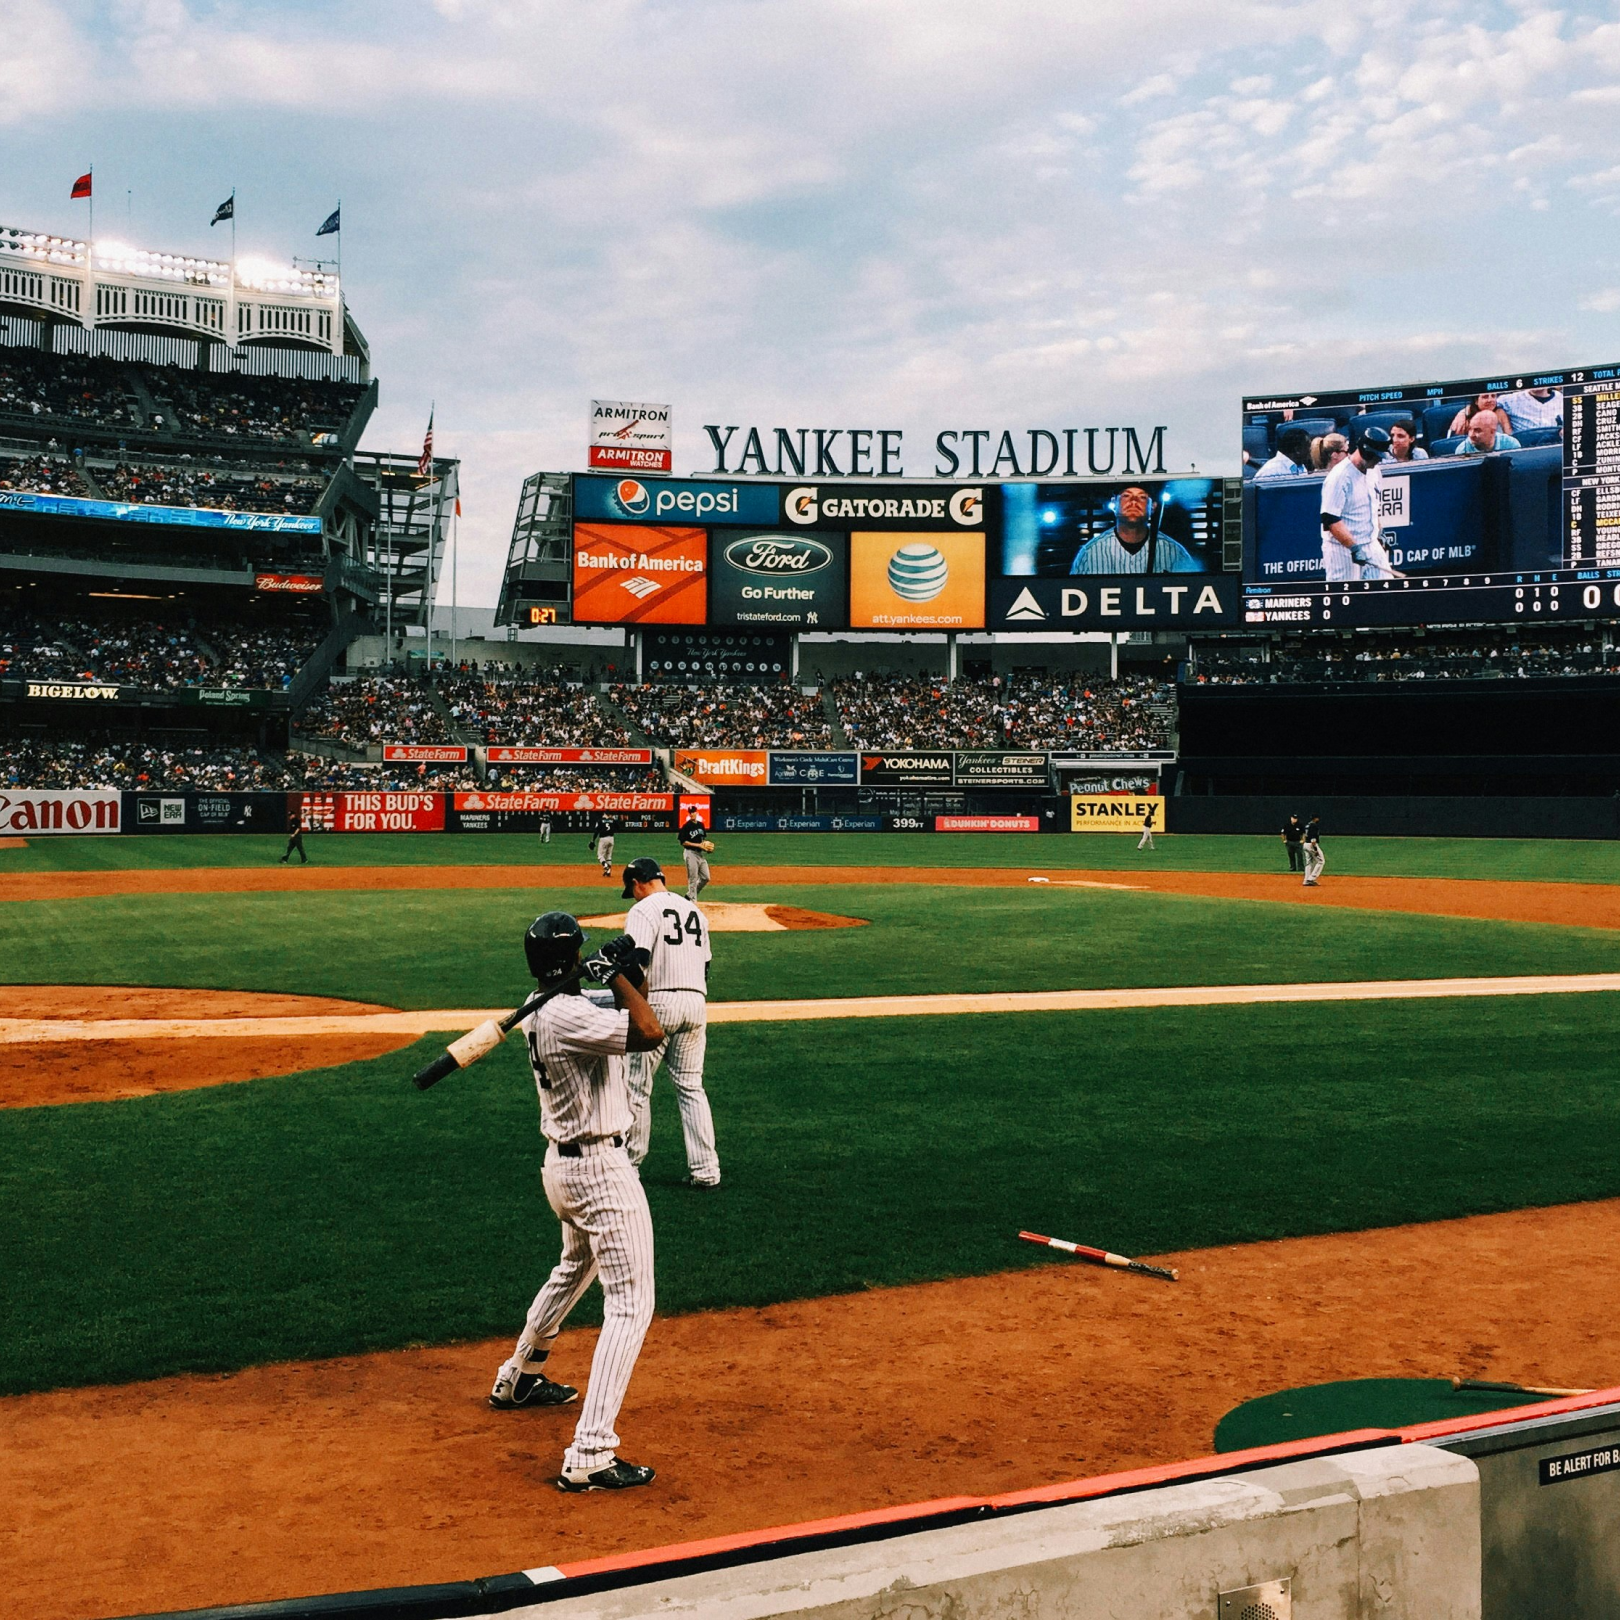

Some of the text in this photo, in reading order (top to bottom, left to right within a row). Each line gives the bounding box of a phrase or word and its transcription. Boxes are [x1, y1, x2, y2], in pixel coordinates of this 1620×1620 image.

[1487, 381, 1508, 390] BALLS
[1516, 379, 1523, 388] 6
[1534, 376, 1563, 386] STRIKES
[1571, 372, 1584, 382] 12
[1593, 370, 1615, 378] TOTAL
[1583, 383, 1613, 393] SEATTLE
[594, 408, 668, 421] ARMITRON
[1596, 409, 1617, 417] CANO
[1596, 417, 1617, 425] CRUZ
[597, 449, 665, 461] ARMITRON
[703, 425, 1168, 478] YANKEE STADIUM
[1601, 476, 1620, 484] YORK
[656, 488, 738, 517] pepsi
[784, 487, 984, 526] G GATORADE G
[222, 513, 317, 531] New York Yankees
[578, 552, 704, 572] Bank of America
[746, 541, 812, 569] Ford
[1264, 562, 1283, 574] THE
[1287, 559, 1325, 572] OFFICIA
[1407, 549, 1428, 562] CAP
[1432, 547, 1445, 559] OF
[1577, 571, 1600, 579] BALLS
[256, 577, 322, 590] Budweiser
[742, 587, 815, 600] Go Further
[1061, 586, 1223, 616] DELTA
[1264, 585, 1600, 609] MARINERS 0 0 0 1 0 0
[531, 608, 556, 623] 0:27
[737, 612, 801, 621] tristateford.com
[1265, 600, 1558, 621] YANKEES 0 0 0 0
[872, 614, 962, 626] att.yankees.com
[199, 689, 250, 702] Poland Spring
[698, 758, 765, 778] DraftKings
[883, 758, 950, 769] YOKOHAMA
[957, 754, 995, 769] Yankees
[1069, 778, 1150, 794] Peanut Chews
[198, 804, 230, 812] ON-FIELD
[345, 795, 434, 811] THIS BUD'S
[1076, 803, 1159, 816] STANLEY
[345, 813, 416, 829] FOR YOU.
[737, 820, 875, 828] Experian Experian Experian
[662, 908, 702, 947] 34
[1550, 1452, 1611, 1476] BE ALERT FOR
